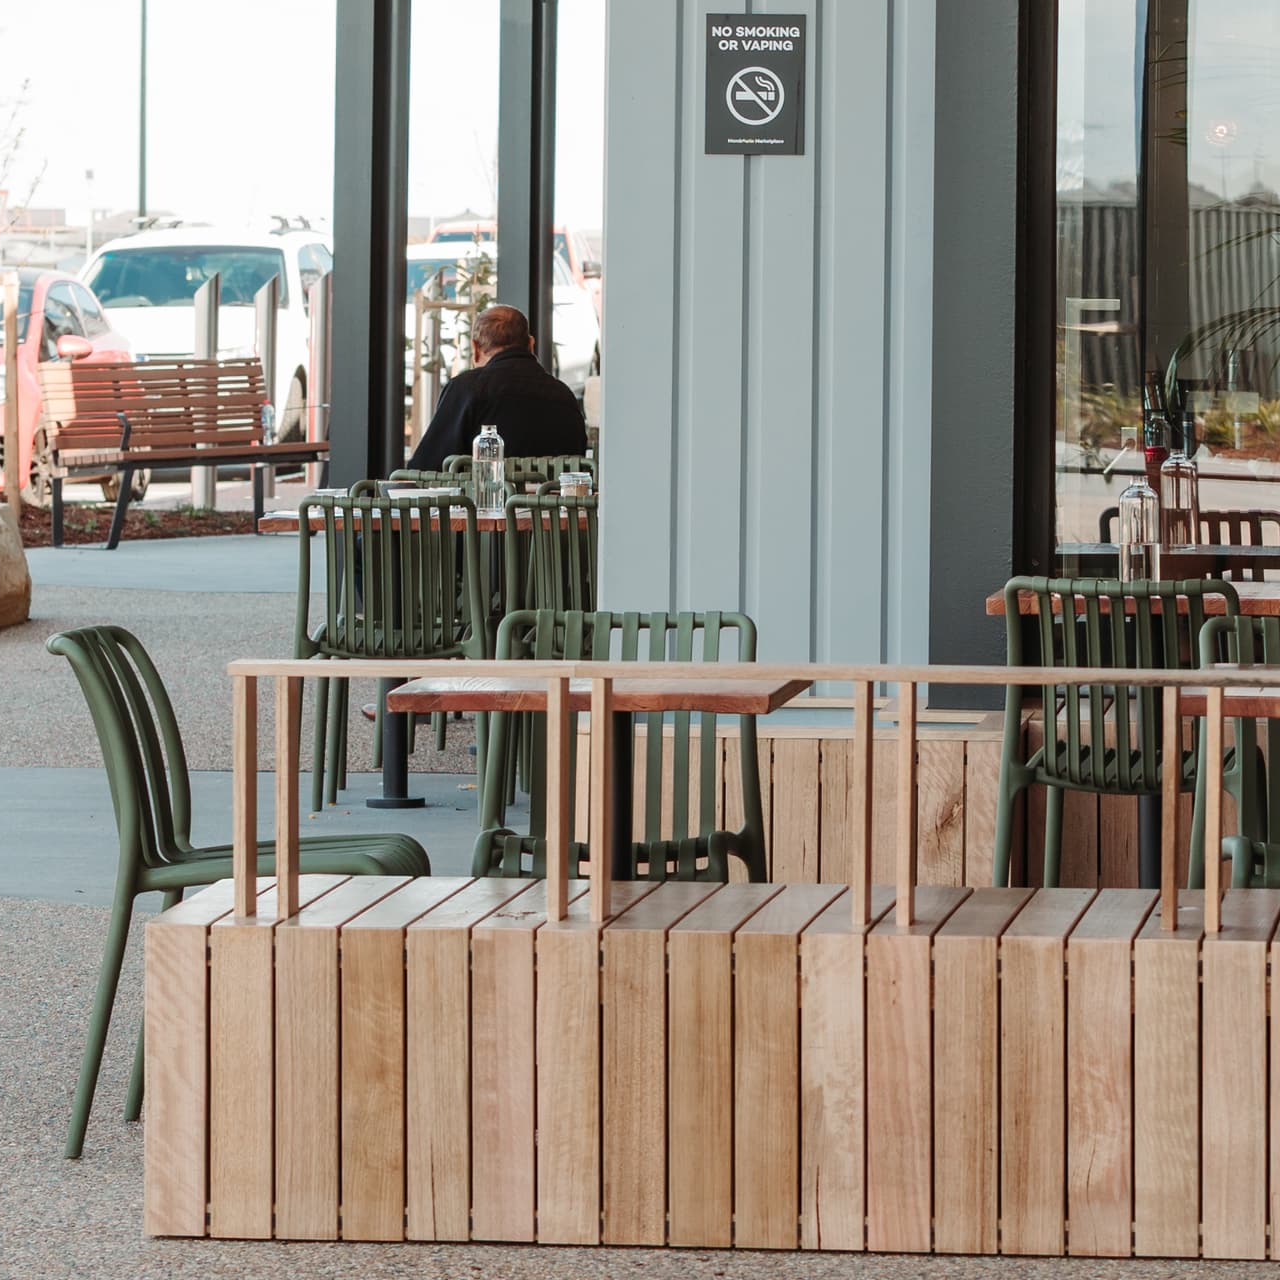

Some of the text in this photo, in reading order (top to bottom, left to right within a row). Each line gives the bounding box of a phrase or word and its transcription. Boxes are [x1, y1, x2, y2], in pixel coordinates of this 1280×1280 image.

[711, 26, 801, 38] NO SMOKING
[718, 40, 794, 51] OR VAPING
